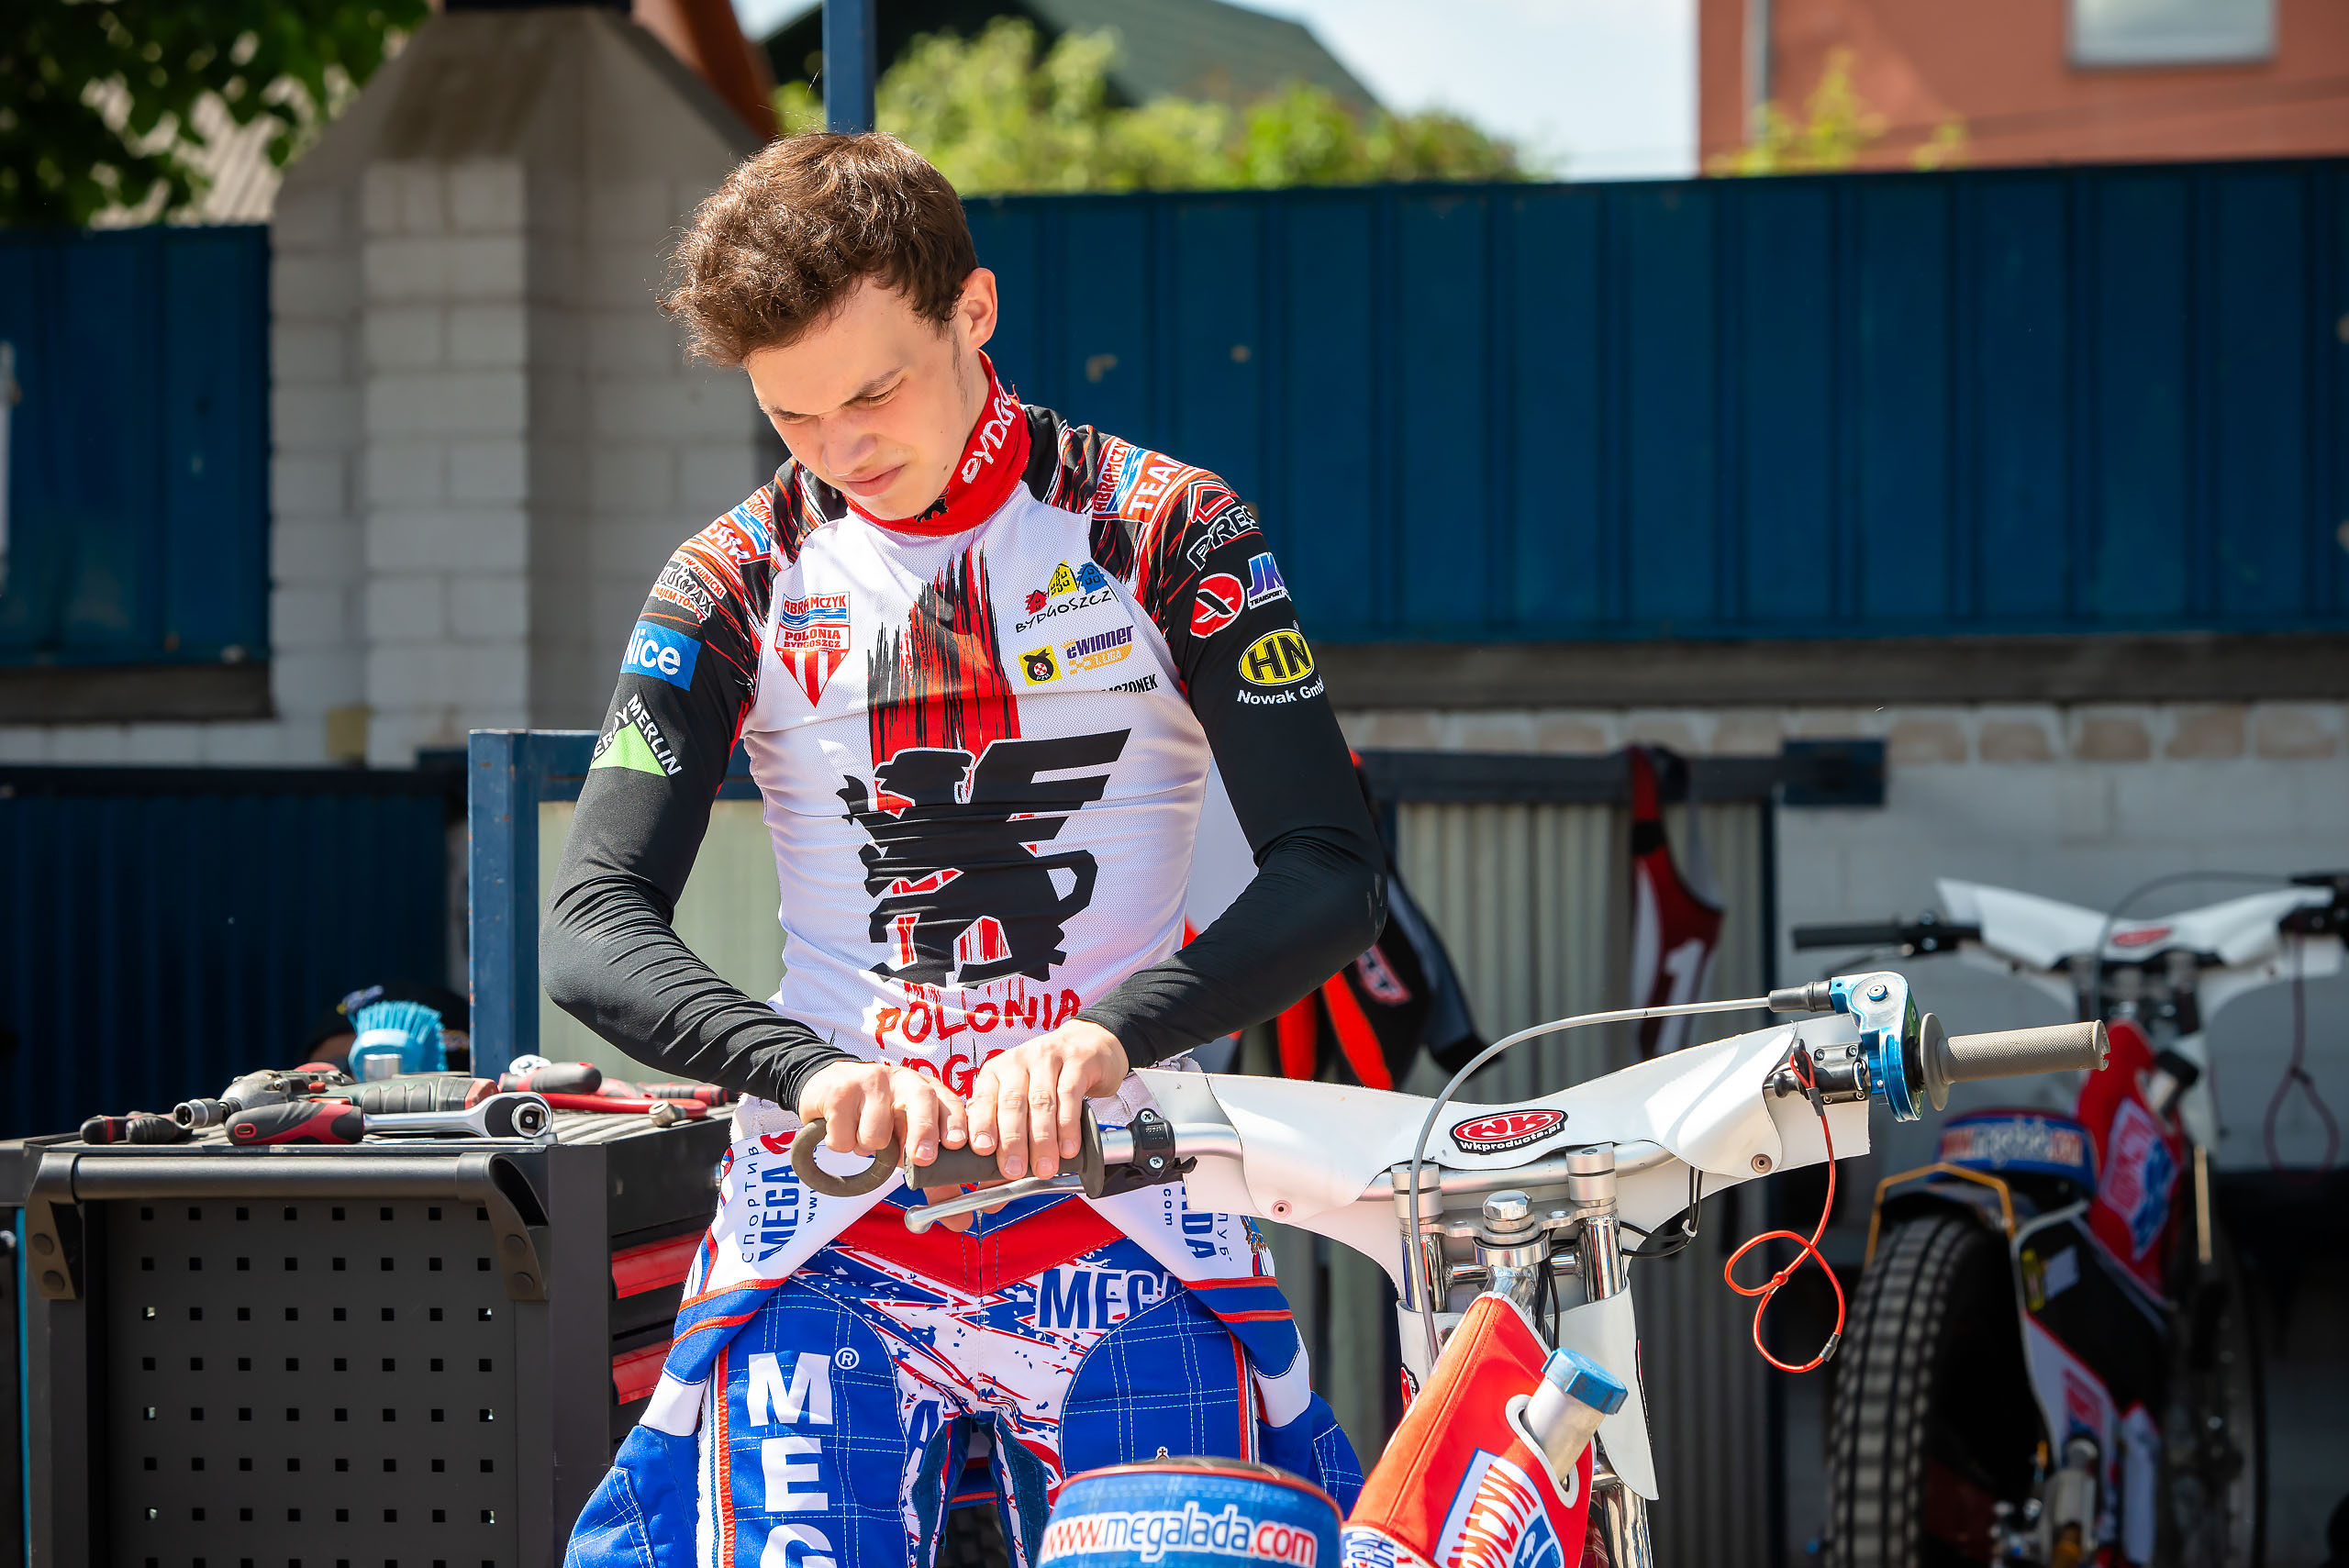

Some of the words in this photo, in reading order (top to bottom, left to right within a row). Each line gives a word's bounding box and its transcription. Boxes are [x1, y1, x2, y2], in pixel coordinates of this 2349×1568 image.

[1093, 439, 1130, 512] ABRAMCZY
[784, 595, 846, 615] ABRAMCZYK
[1015, 590, 1112, 633] BYDGOSZCZ
[784, 639, 841, 649] BYDGOSZCZ
[785, 628, 841, 641] POLONIA
[1247, 635, 1312, 681] HN
[1236, 689, 1297, 705] Nowak
[627, 694, 683, 776] MERLIN
[875, 988, 1081, 1050] POLONIA
[1039, 1269, 1181, 1329] MEG
